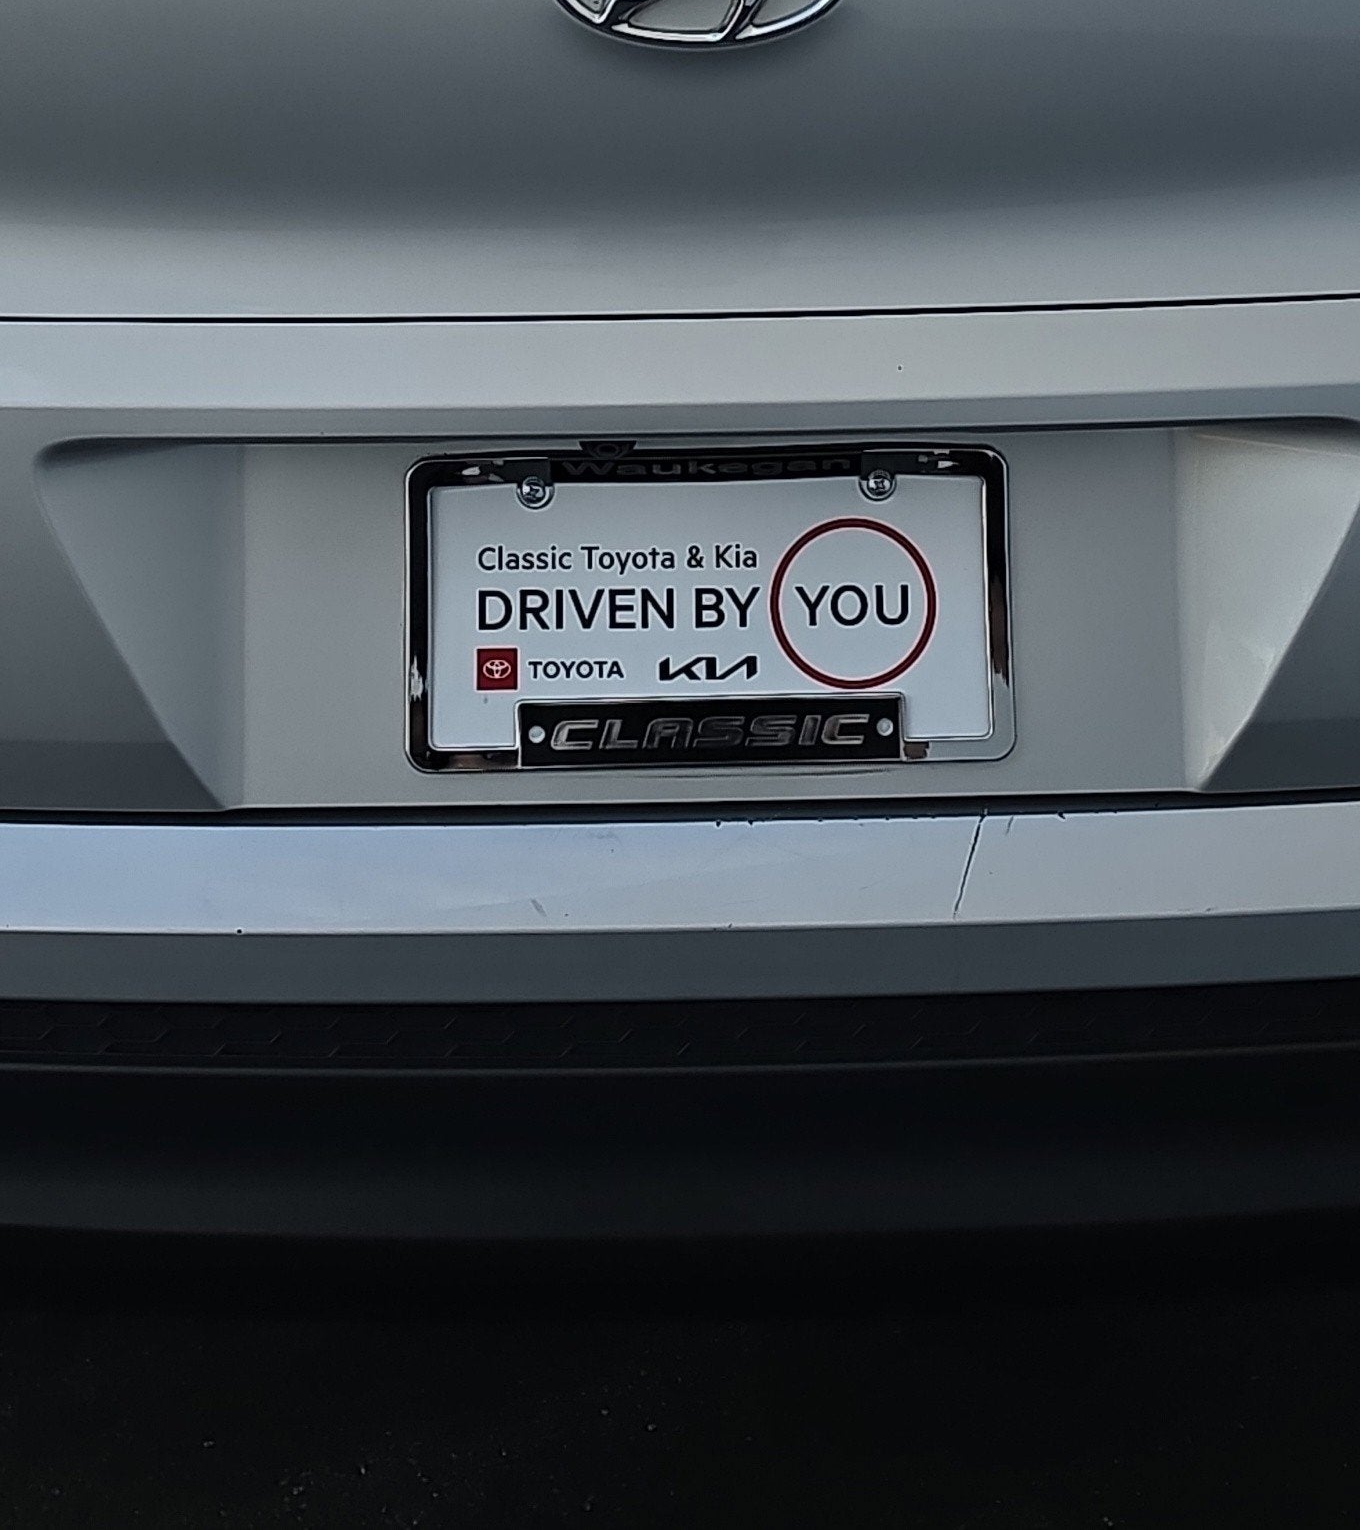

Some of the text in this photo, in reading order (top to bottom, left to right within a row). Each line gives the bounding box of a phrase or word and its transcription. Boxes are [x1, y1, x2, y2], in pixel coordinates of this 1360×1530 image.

[560, 456, 852, 477] Waukegan
[479, 544, 756, 574] Classic Toyota & Kia
[479, 585, 908, 630] DRIVEN BY YOU
[529, 661, 623, 678] TOYOTA
[549, 712, 870, 751] CLASSIC
